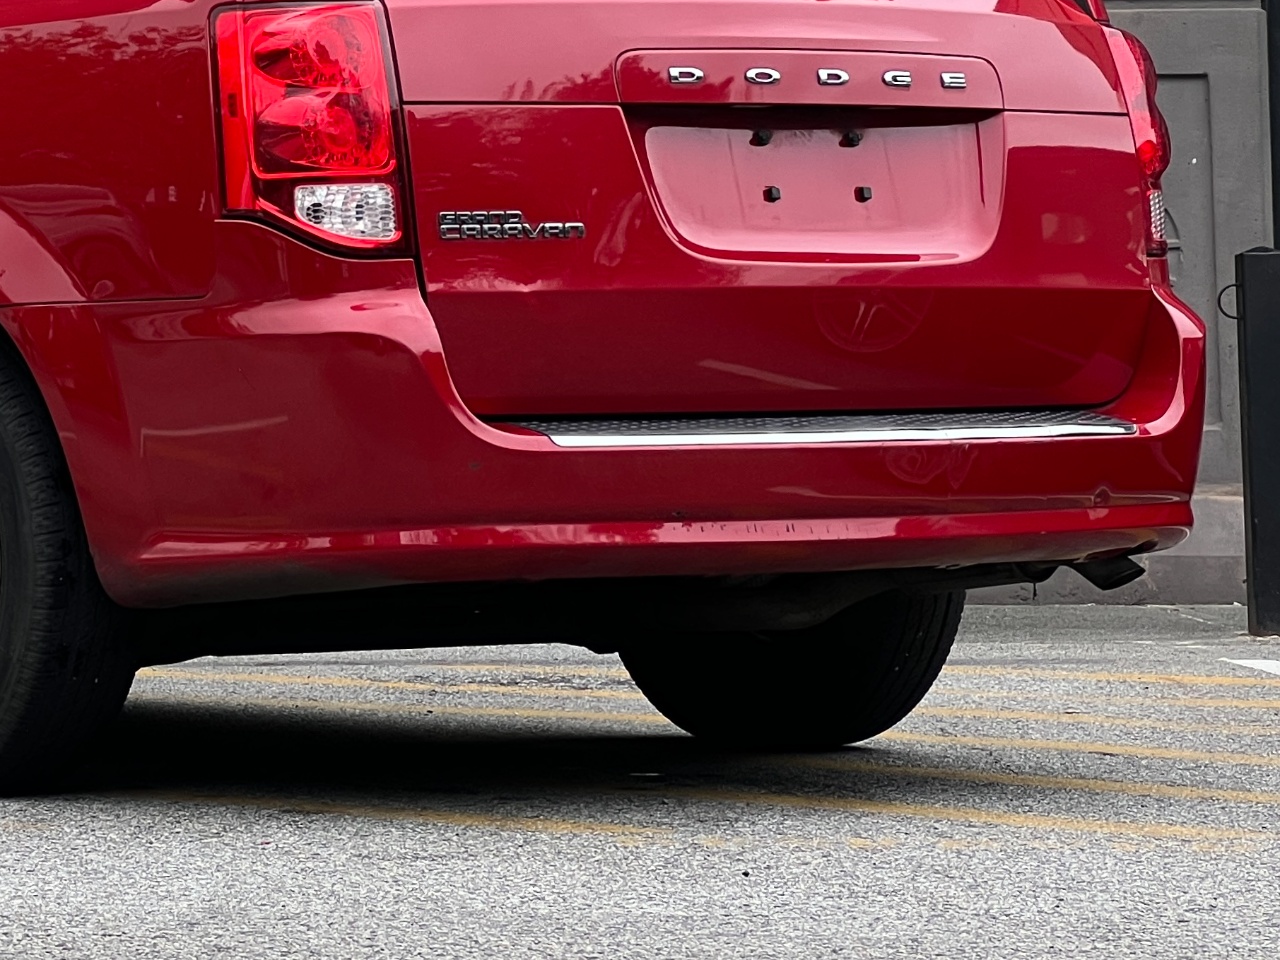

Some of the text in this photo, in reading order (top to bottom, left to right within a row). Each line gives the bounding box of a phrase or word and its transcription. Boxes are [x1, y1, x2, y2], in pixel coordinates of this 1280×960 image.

[668, 66, 967, 89] DODGE
[439, 210, 523, 224] GRAND
[439, 223, 586, 239] CARAVAN
